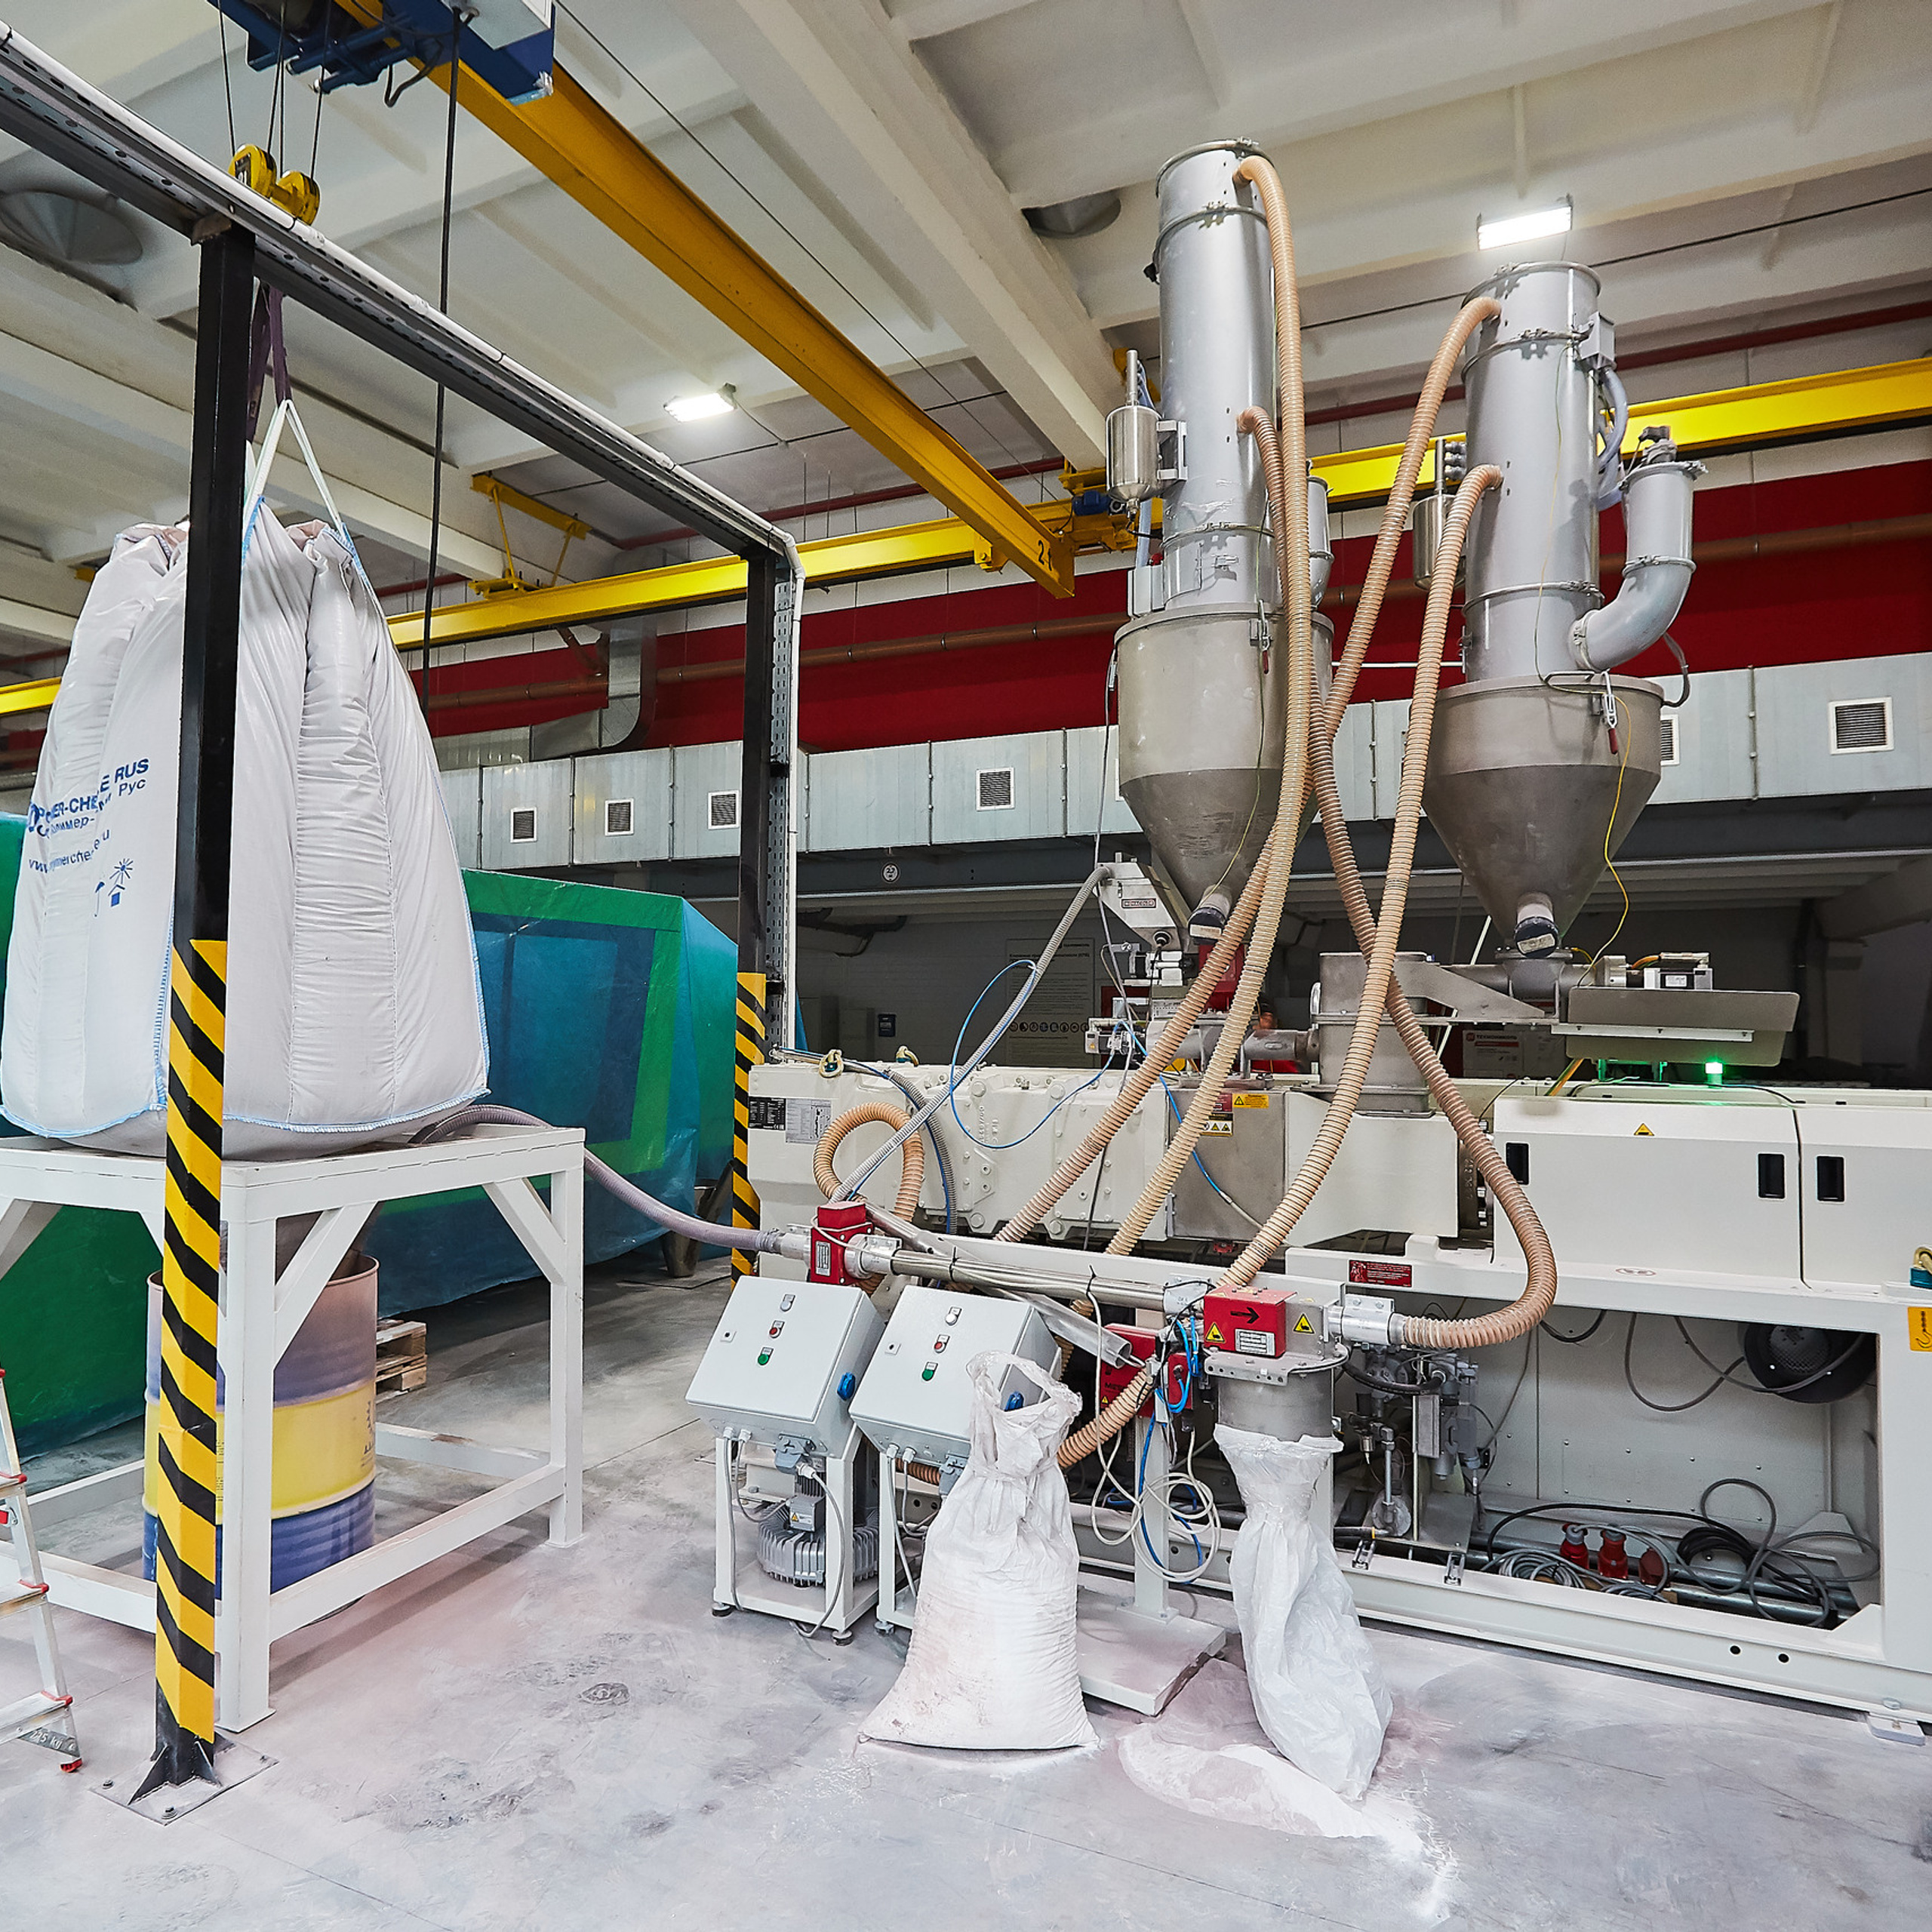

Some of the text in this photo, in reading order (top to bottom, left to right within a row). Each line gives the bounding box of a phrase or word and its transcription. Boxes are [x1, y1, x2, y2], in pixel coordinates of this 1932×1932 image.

[115, 758, 149, 783] RUS
[118, 779, 146, 797] Рус
[50, 1736, 63, 1750] kg
